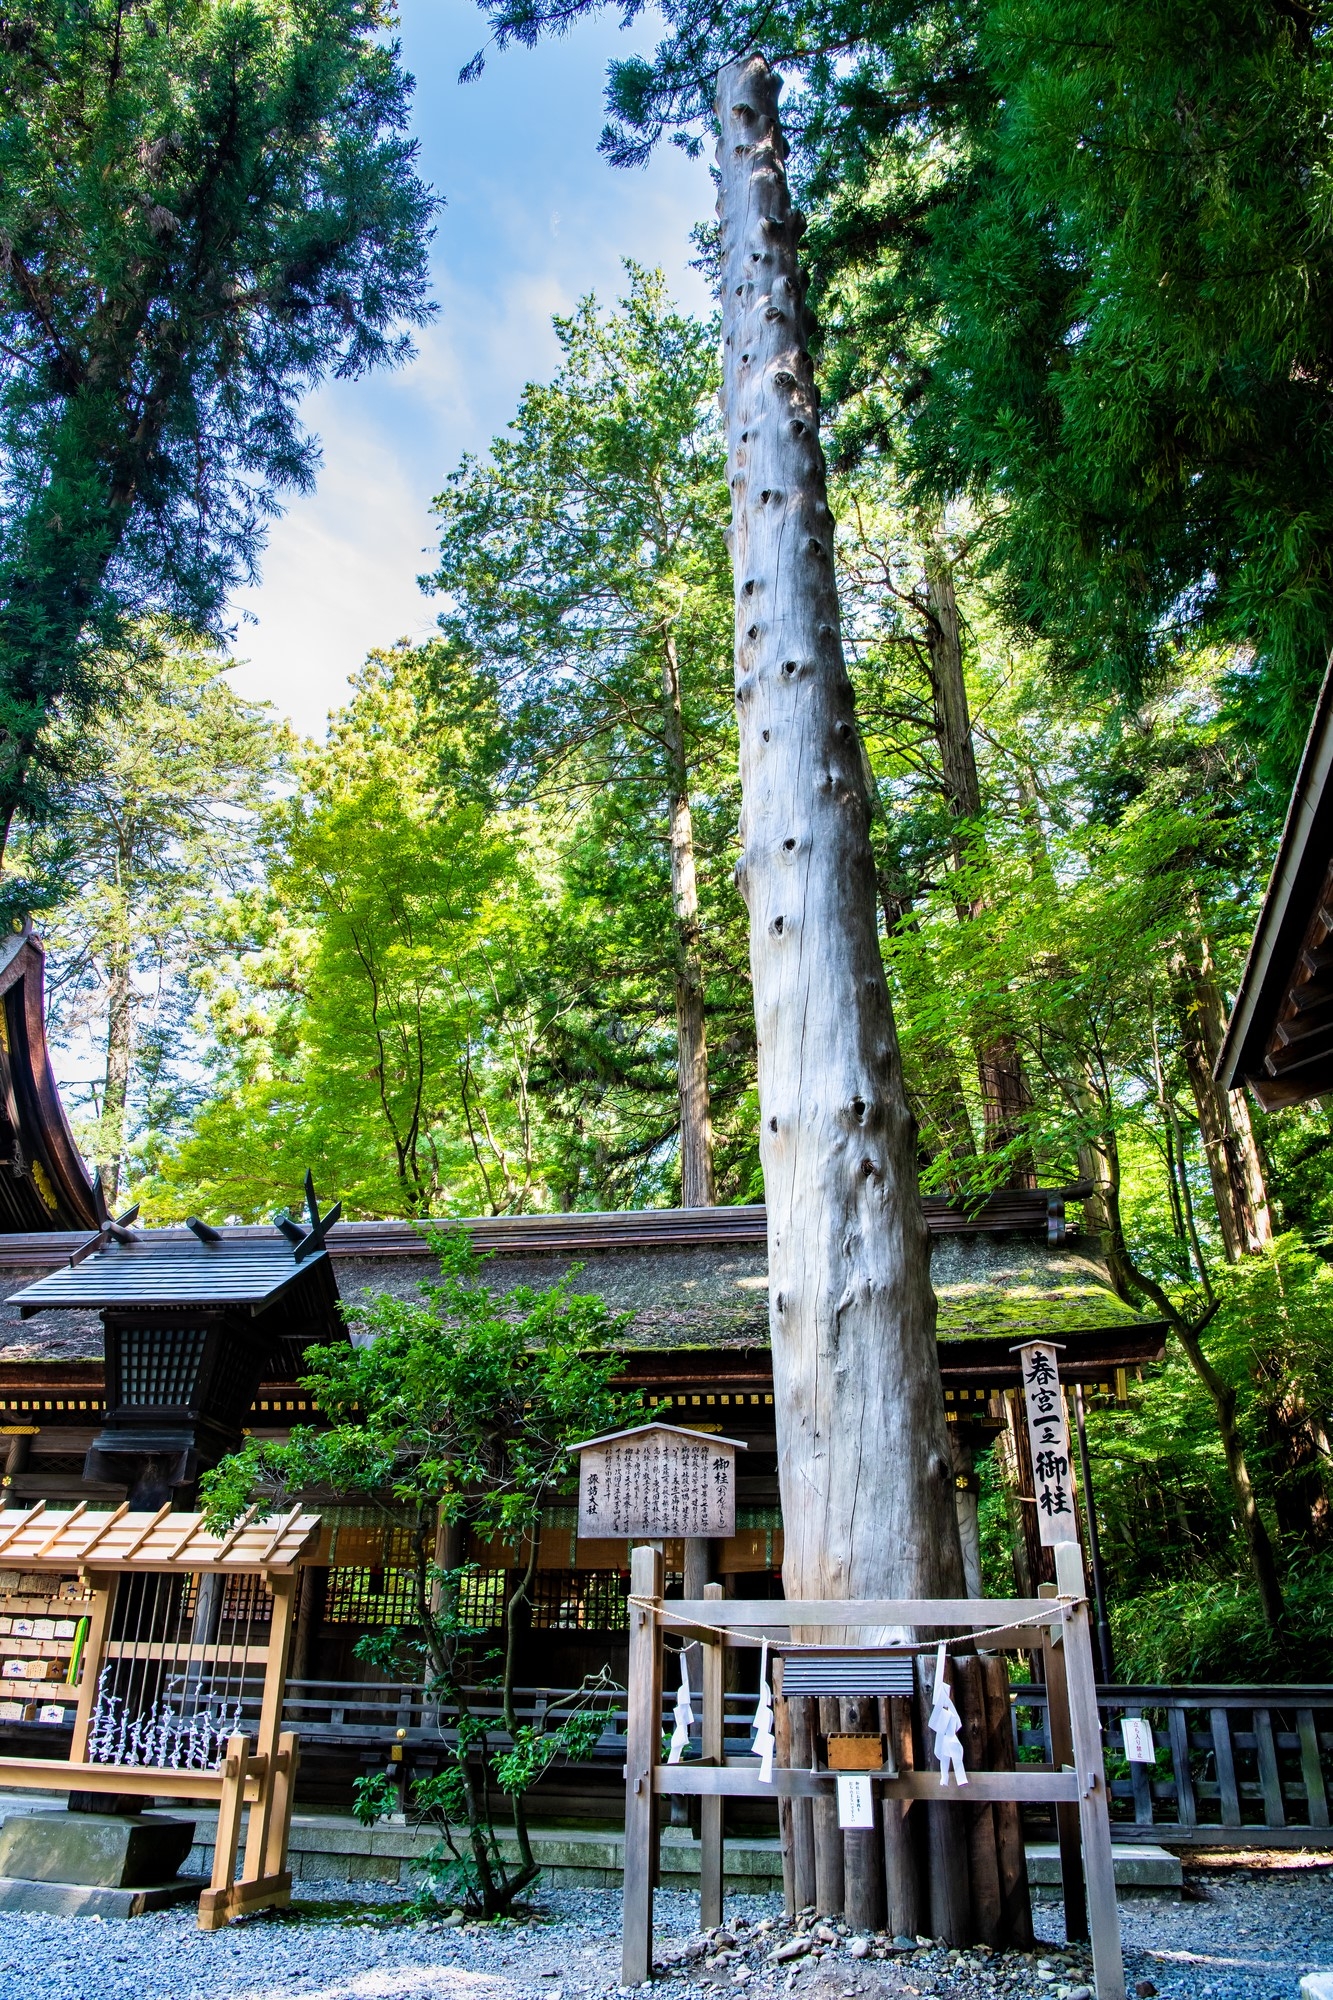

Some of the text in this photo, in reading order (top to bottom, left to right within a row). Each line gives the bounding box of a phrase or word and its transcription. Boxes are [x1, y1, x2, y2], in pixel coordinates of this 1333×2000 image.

[1024, 1350, 1072, 1516] 春宮一之御柱
[586, 1473, 600, 1515] 諏訪大社
